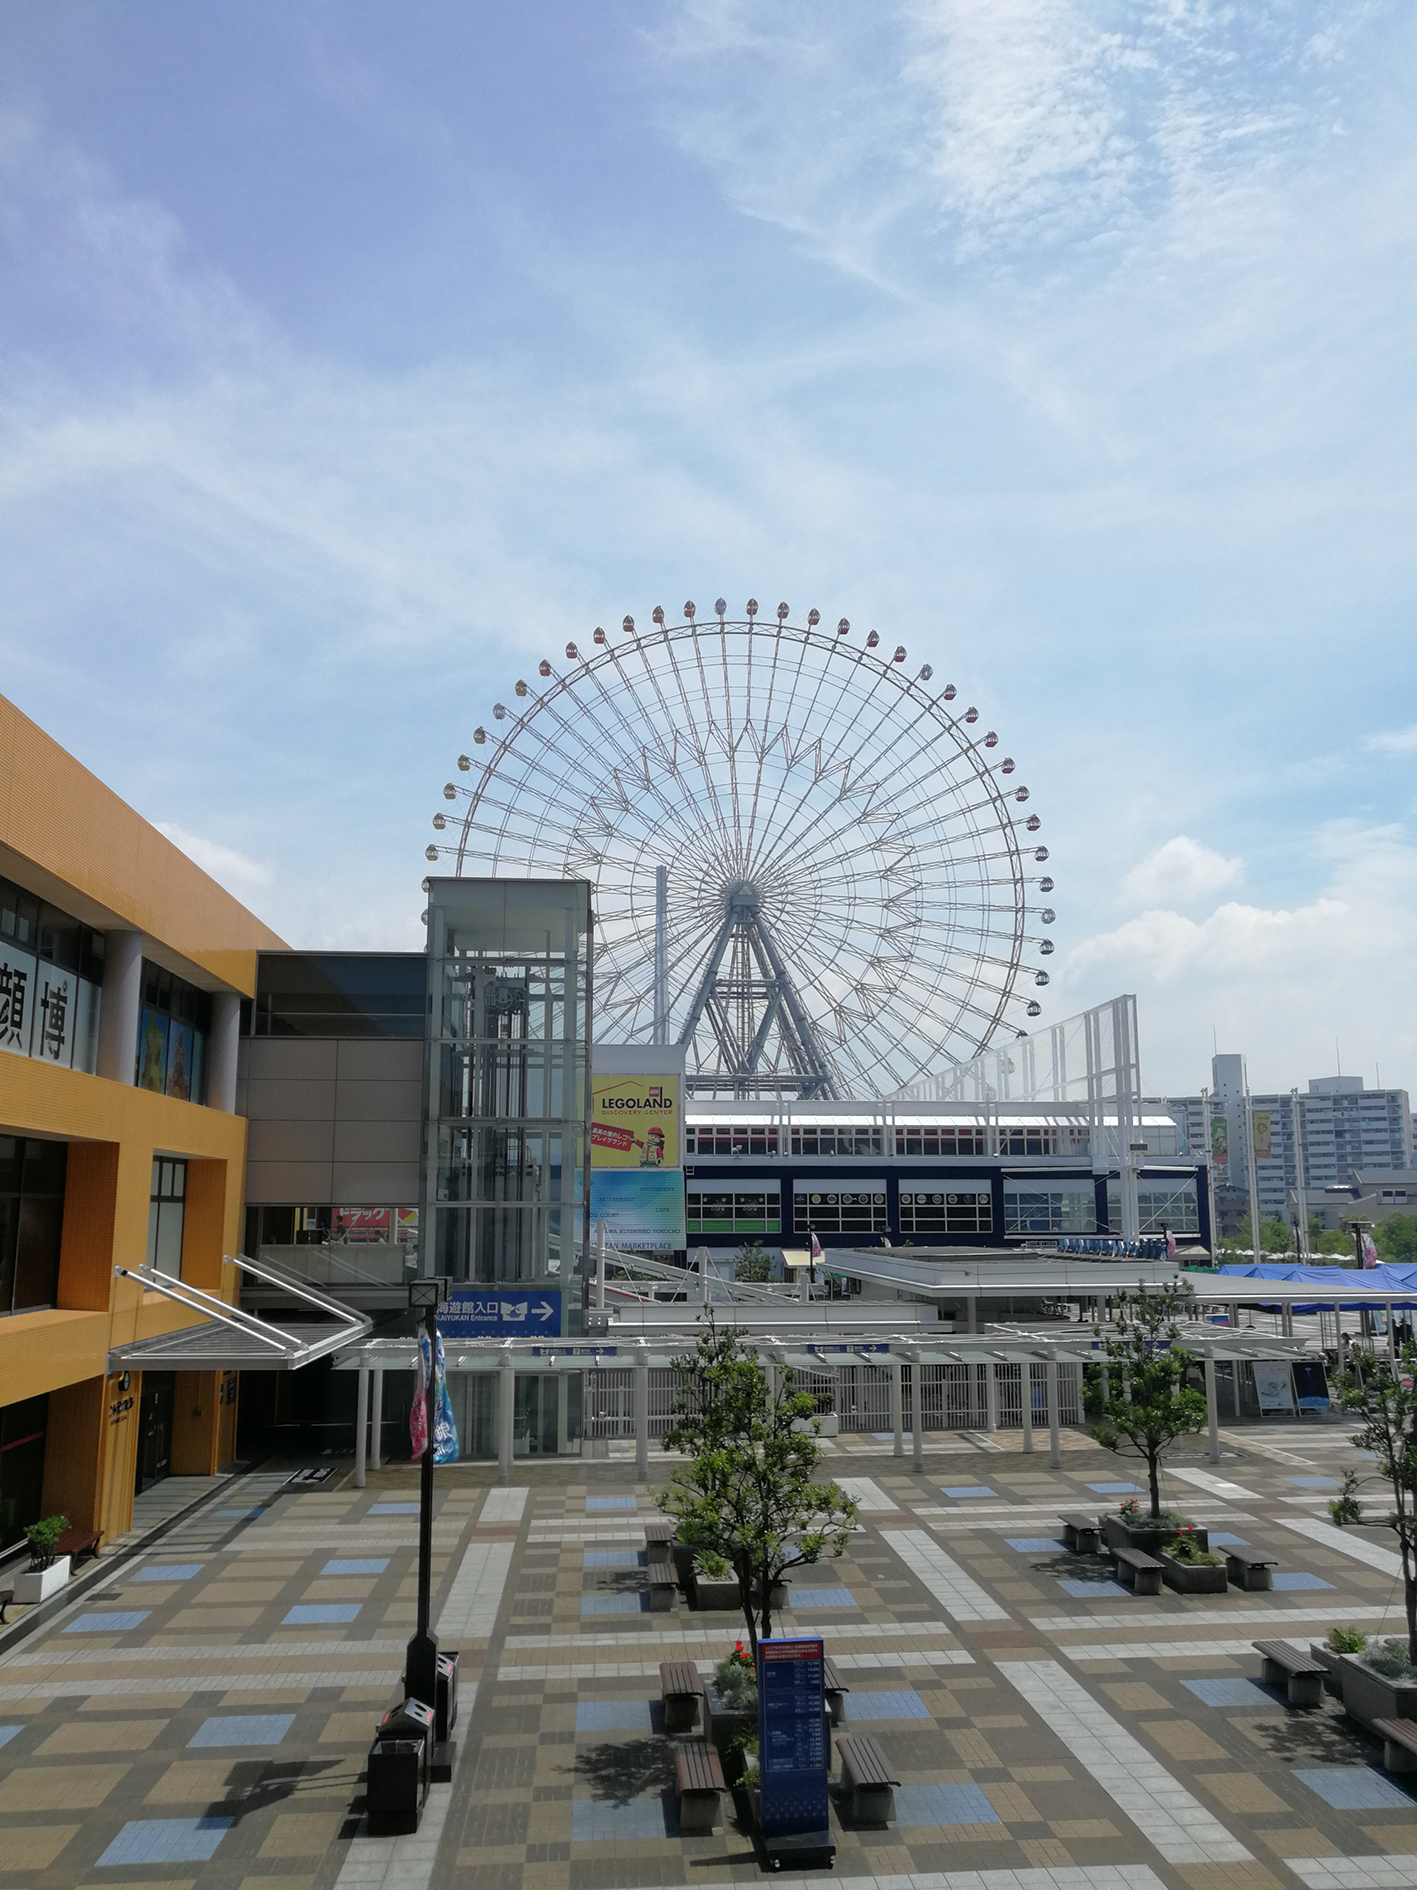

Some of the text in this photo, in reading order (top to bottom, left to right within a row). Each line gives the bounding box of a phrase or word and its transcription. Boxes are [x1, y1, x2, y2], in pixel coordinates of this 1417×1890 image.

[602, 1087, 673, 1109] LEGOLAND
[592, 1134, 628, 1147] プレイグランド
[436, 1301, 498, 1314] 海遊館入口
